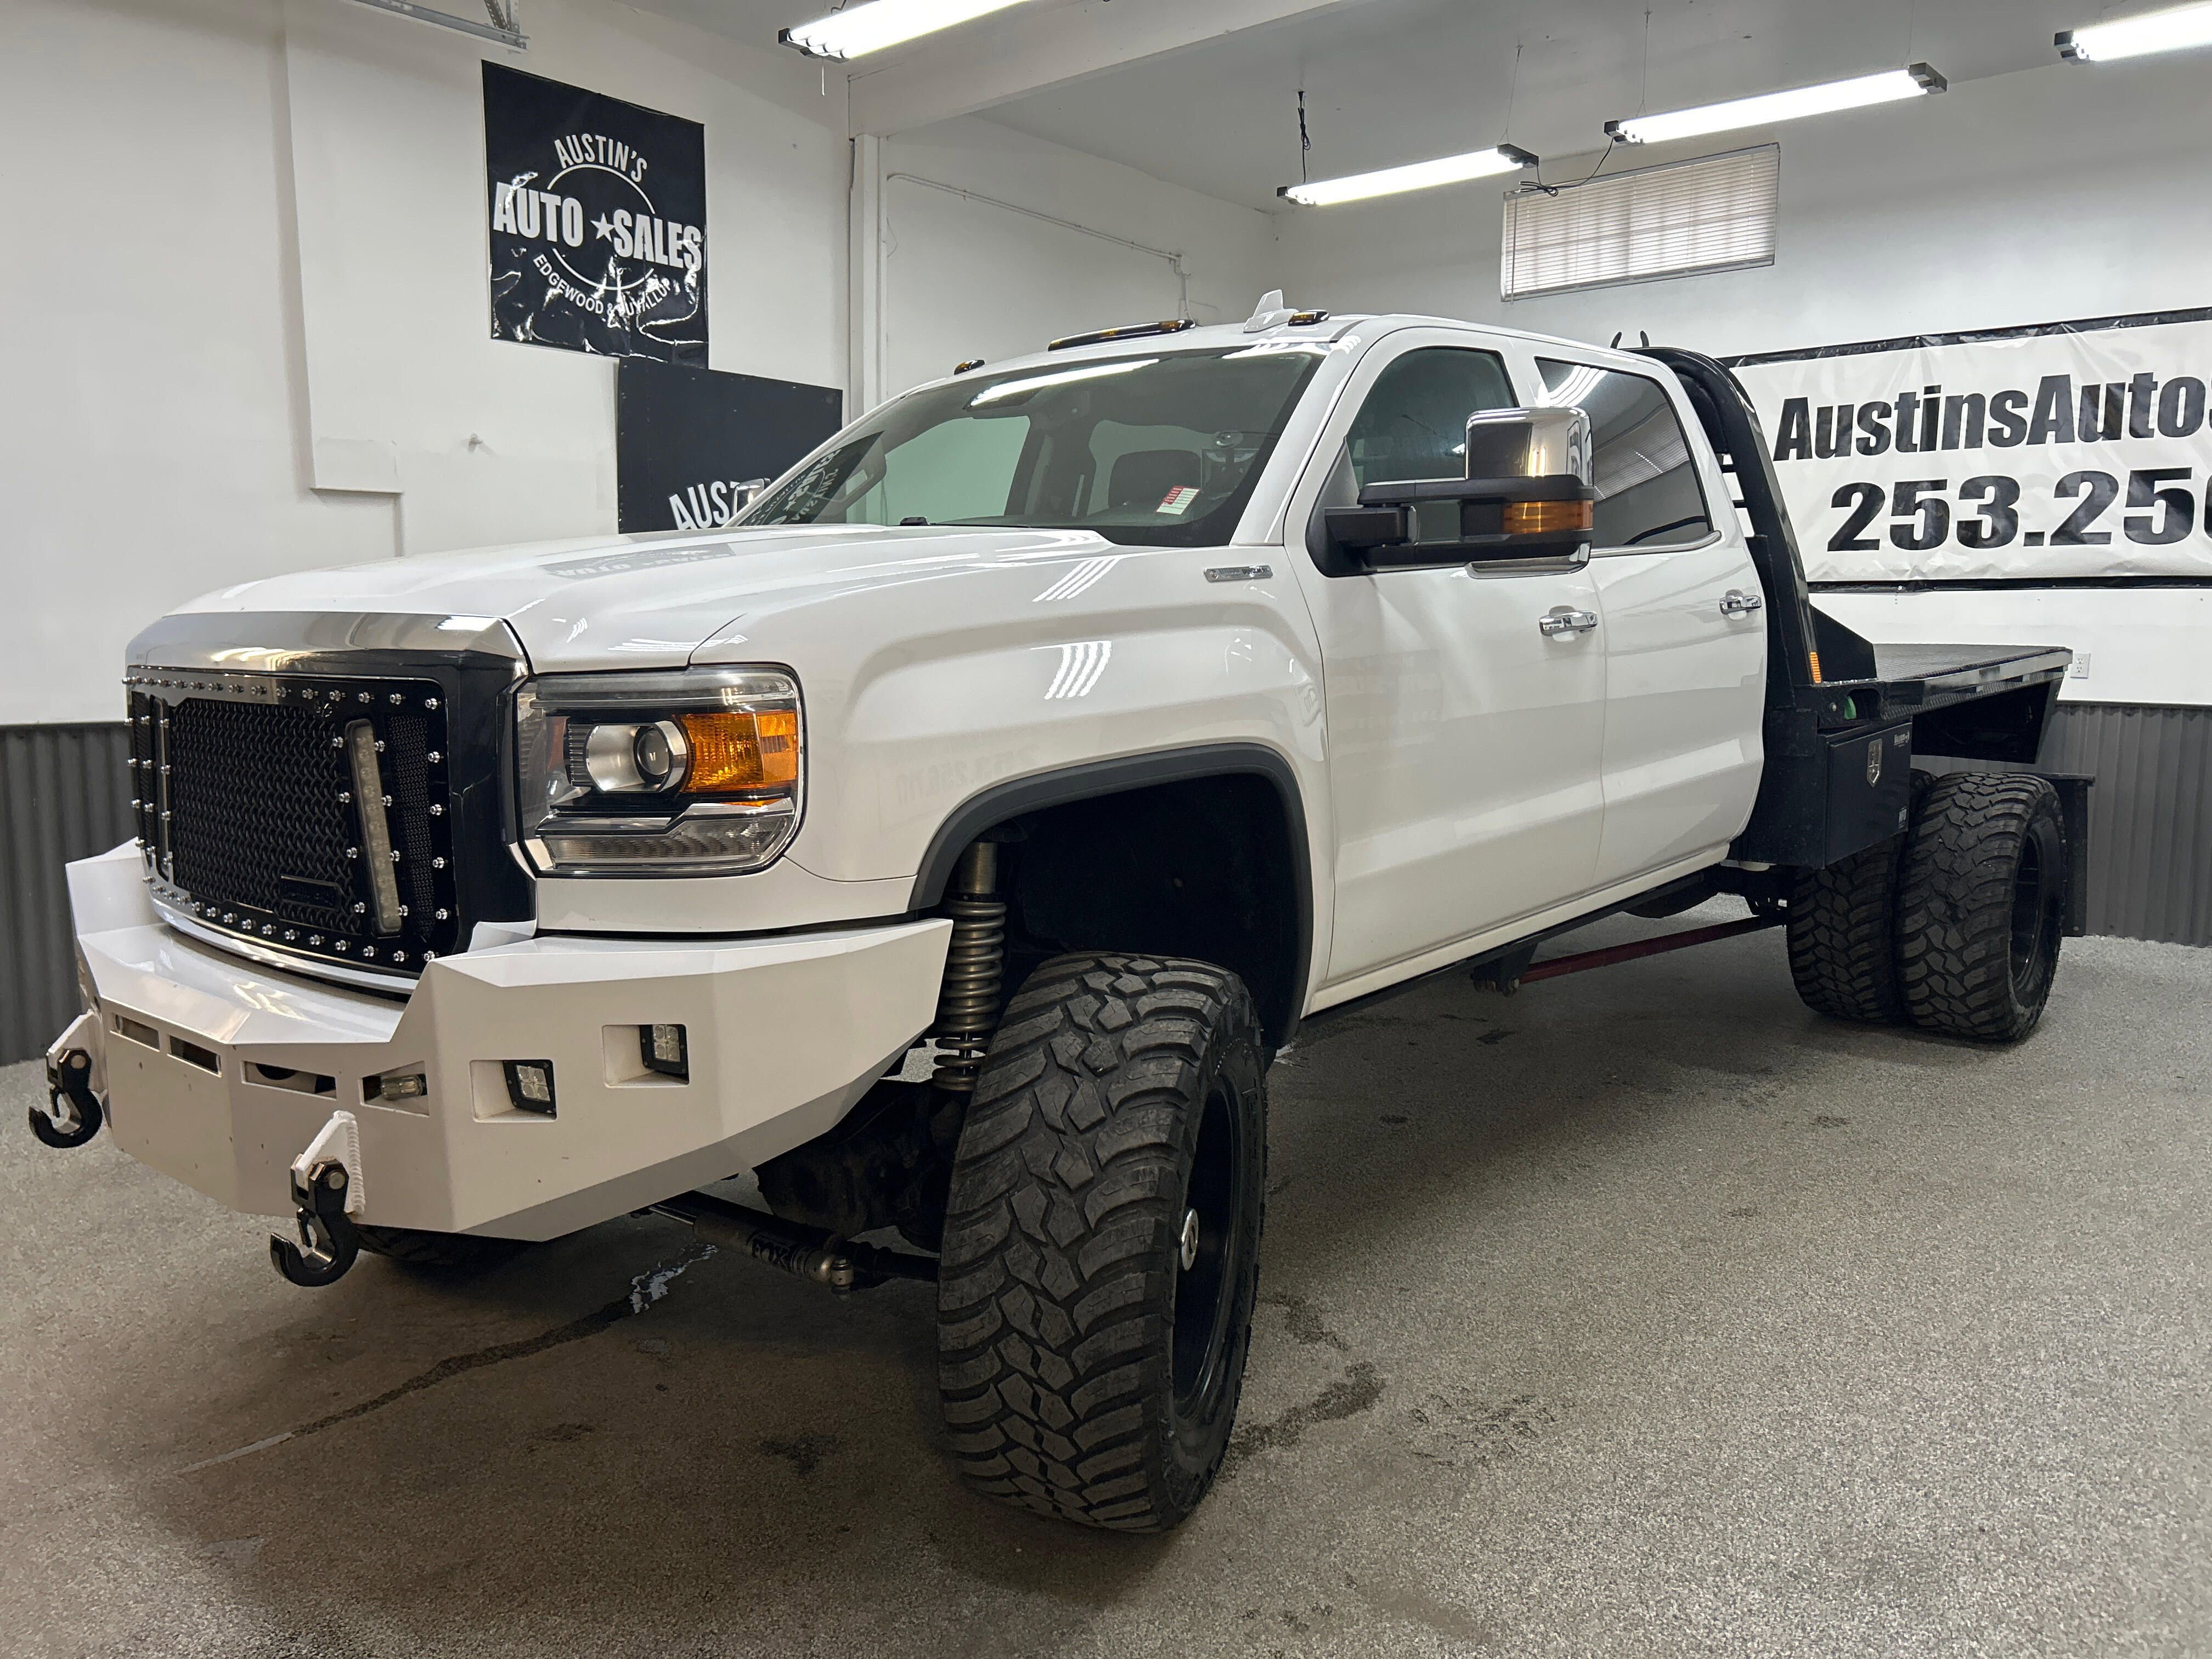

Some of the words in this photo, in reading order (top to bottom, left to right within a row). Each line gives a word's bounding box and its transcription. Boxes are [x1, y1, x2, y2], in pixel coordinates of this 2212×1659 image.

[554, 133, 647, 182] AUSTIN'S
[493, 182, 583, 247] AUTO
[613, 208, 702, 272] SALES
[533, 254, 603, 314] EDGEWOOD
